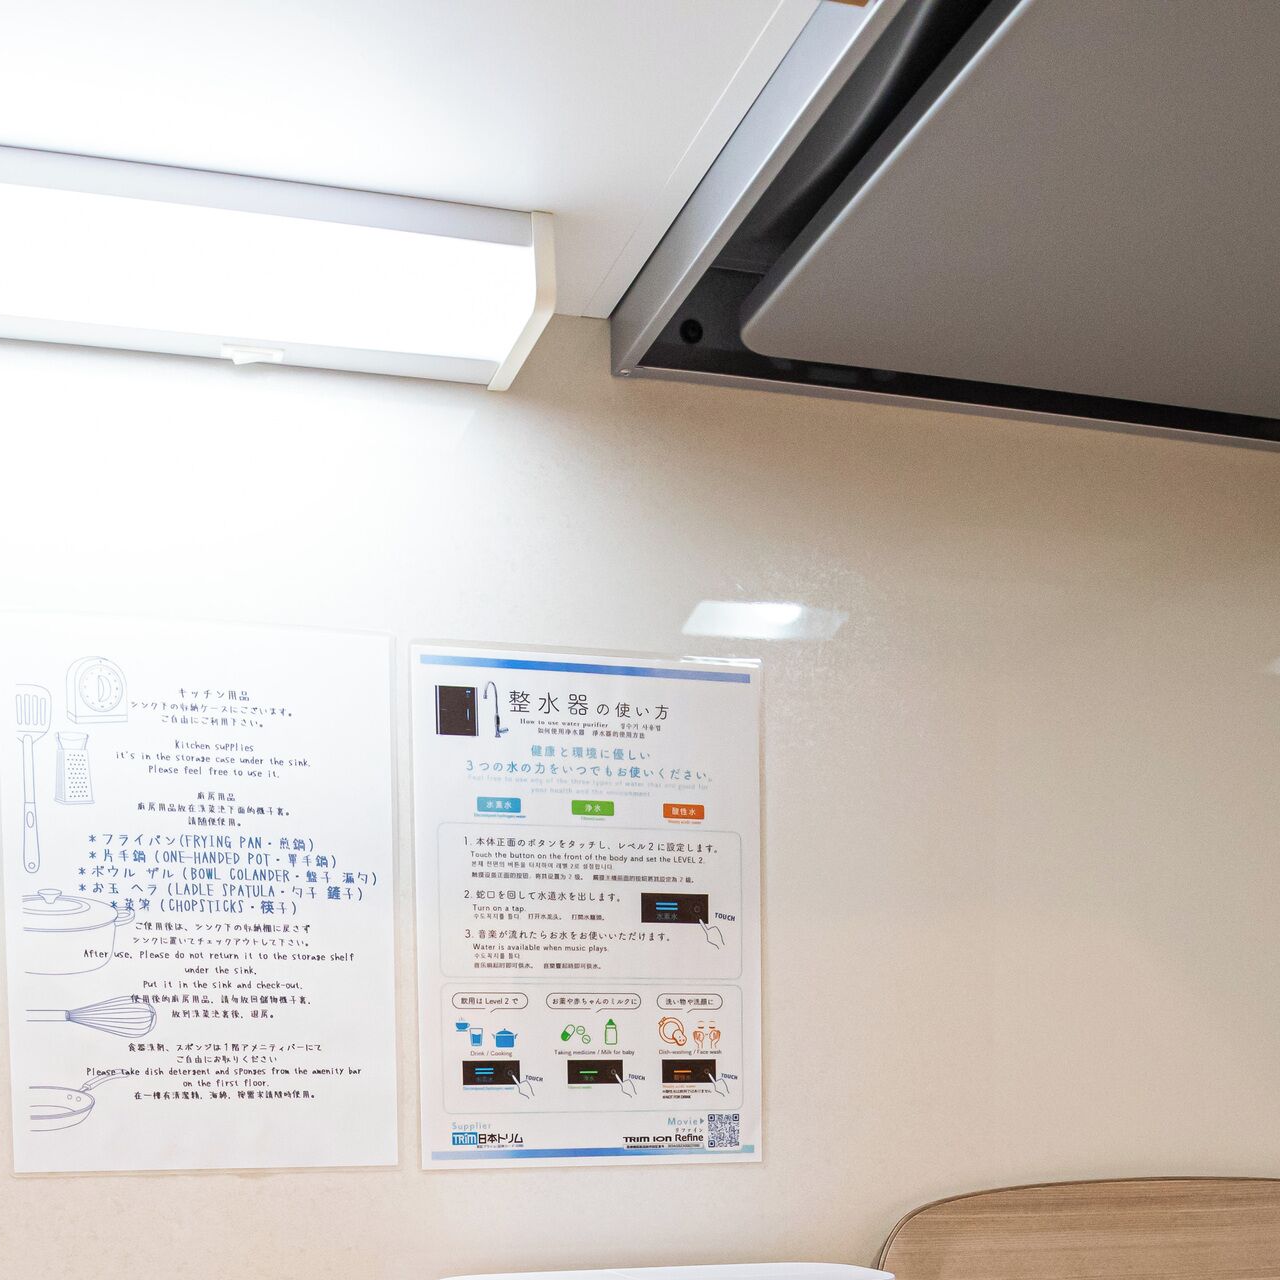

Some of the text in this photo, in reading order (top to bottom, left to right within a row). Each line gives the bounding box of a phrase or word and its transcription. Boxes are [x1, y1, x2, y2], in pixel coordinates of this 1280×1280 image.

[180, 687, 250, 702] キッチン用品
[508, 689, 670, 721] 整水器の使い方
[161, 714, 264, 728] ご自由にご利用下さい。
[582, 721, 609, 729] purifier
[174, 739, 254, 753] Kitchen supplies
[530, 744, 651, 761] 健康と環境に優しい
[116, 751, 135, 760] it's
[156, 752, 171, 761] the
[175, 754, 211, 763] storage
[215, 756, 236, 764] case
[239, 756, 264, 765] under
[269, 757, 284, 766] the
[288, 758, 311, 767] sink.
[148, 764, 280, 779] Please feel free to use it.
[671, 806, 696, 816] 酸性水
[464, 835, 473, 846] 1.
[103, 848, 146, 864] 片手鍋
[470, 850, 493, 858] Touch
[494, 851, 507, 859] the
[509, 851, 535, 859] button
[549, 852, 562, 860] the
[563, 852, 582, 861] front
[584, 853, 593, 861] of
[594, 853, 607, 862] the
[609, 854, 628, 864] body
[630, 855, 644, 863] and
[673, 855, 696, 864] LEVEL
[91, 865, 221, 881] ボウル ザル (BOWL
[92, 882, 214, 897] お玉 ヘラ (LADLE
[464, 889, 621, 903] 2. 蛇口を回して水道水を出します。
[472, 903, 491, 912] Turn
[511, 905, 527, 914] tap.
[714, 912, 736, 922] TOUCH
[464, 928, 670, 942] 3. 音楽が流れたらお水をお使いいただけます。
[132, 936, 309, 947] シンクに置いてチェックアウトして下さい。
[472, 943, 496, 951] Water
[498, 943, 505, 951] is
[507, 943, 541, 951] available
[564, 944, 586, 952] music
[83, 949, 109, 959] After
[139, 949, 170, 959] Please
[174, 950, 185, 959] do
[209, 952, 239, 960] return
[244, 952, 253, 960] it
[258, 952, 269, 960] to
[273, 951, 288, 961] the
[291, 953, 326, 962] storage
[330, 952, 354, 962] shelf
[184, 965, 257, 976] under the sink.
[143, 980, 303, 990] Put it in the sink and check-out.
[460, 996, 519, 1005] 飲用は Level 2 で
[552, 997, 639, 1008] お薬や赤ちゃんのミルクに
[665, 998, 713, 1006] 洗い物や洗顔に
[490, 1050, 513, 1058] Cooking
[554, 1049, 573, 1057] Taking
[621, 1049, 635, 1057] baby
[709, 1047, 722, 1055] wash
[176, 1054, 277, 1064] ご自由にお取りください
[86, 1066, 362, 1078] Please take dish detergent and sponges from the amenity bar
[719, 1072, 738, 1082] TOUCH
[197, 1079, 212, 1088] the
[215, 1078, 239, 1088] first
[243, 1078, 270, 1087] floor.
[523, 1074, 544, 1084] TOUCH
[626, 1073, 646, 1083] TOUCH
[450, 1121, 491, 1132] Supplier
[667, 1117, 698, 1126] Movie
[478, 1133, 524, 1145] 日本トリム
[674, 1133, 704, 1142] Refine
